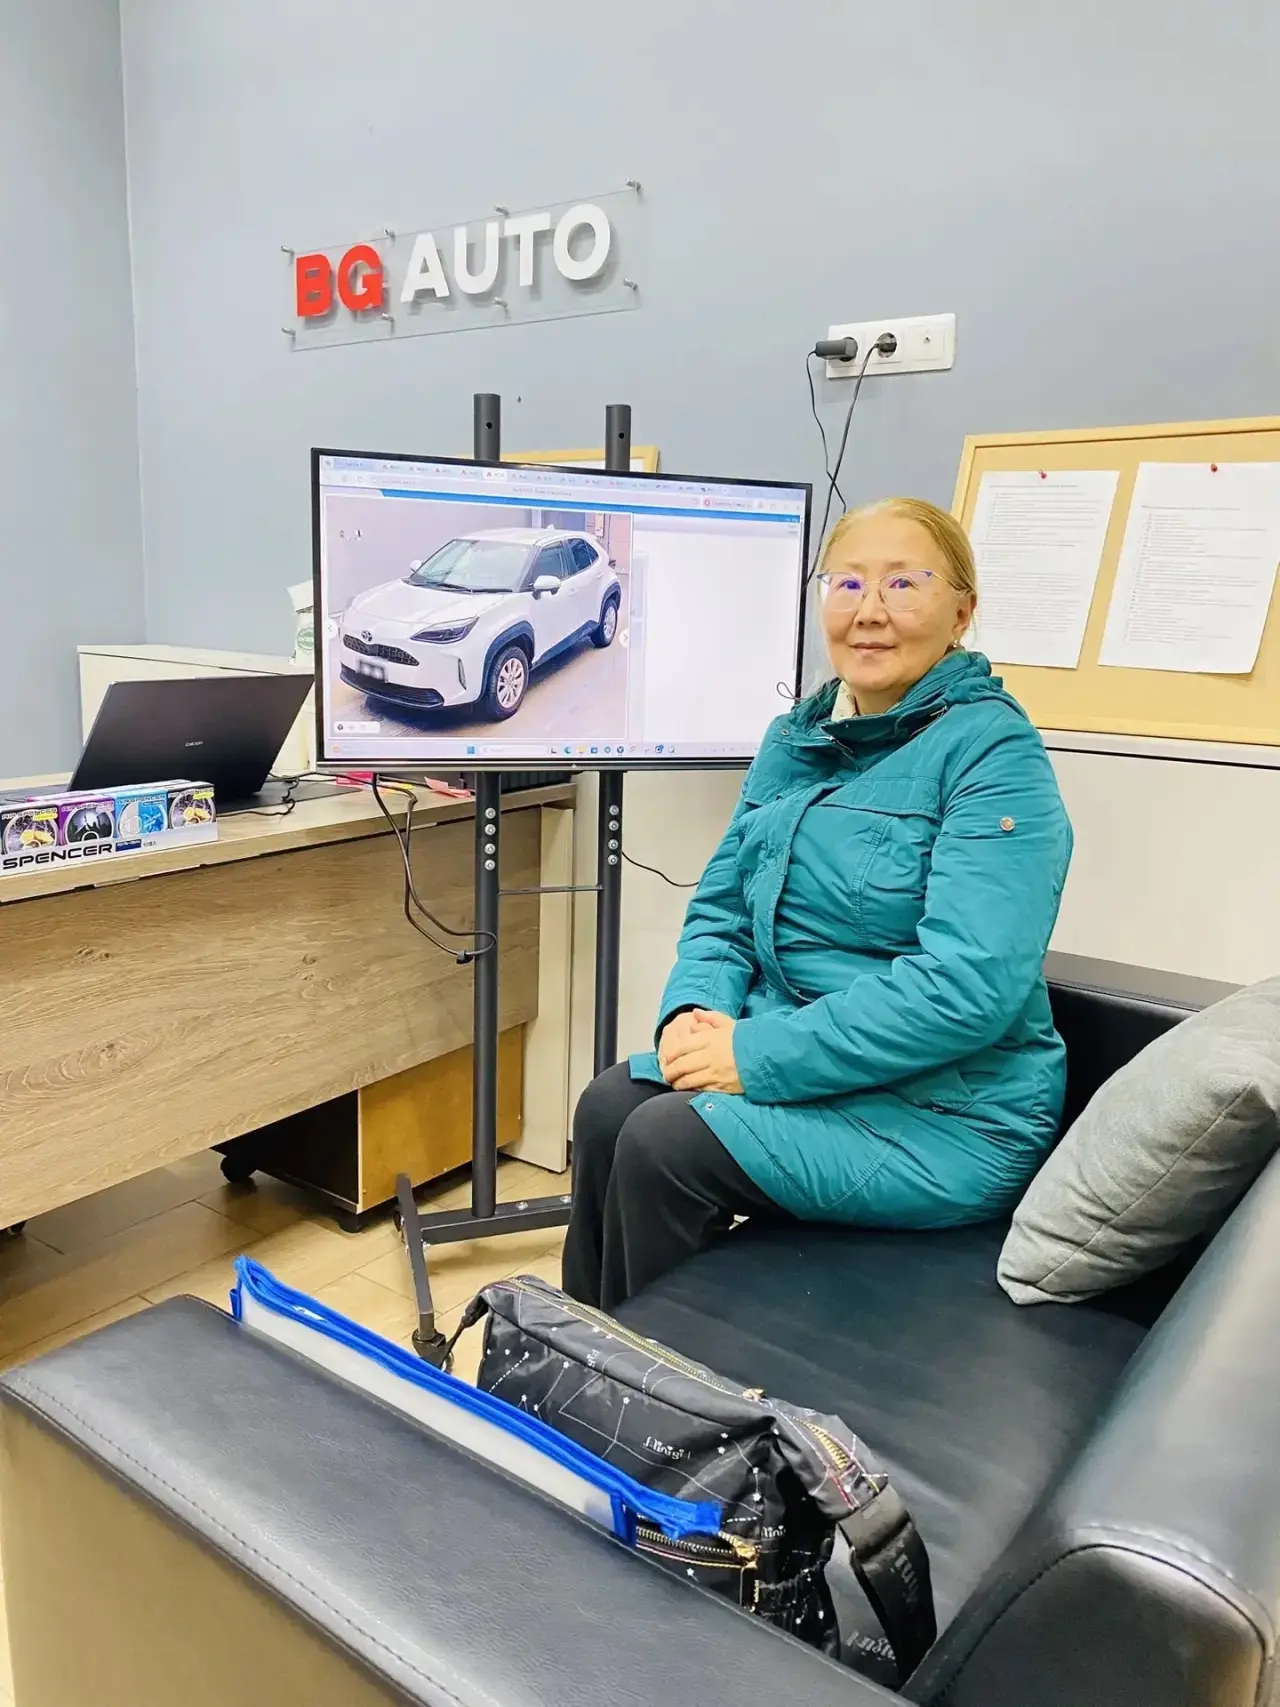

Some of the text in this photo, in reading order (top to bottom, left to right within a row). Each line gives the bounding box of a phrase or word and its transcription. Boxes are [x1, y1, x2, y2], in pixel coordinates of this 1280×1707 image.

[296, 203, 611, 317] BG AUTO
[3, 844, 113, 870] SPENCER
